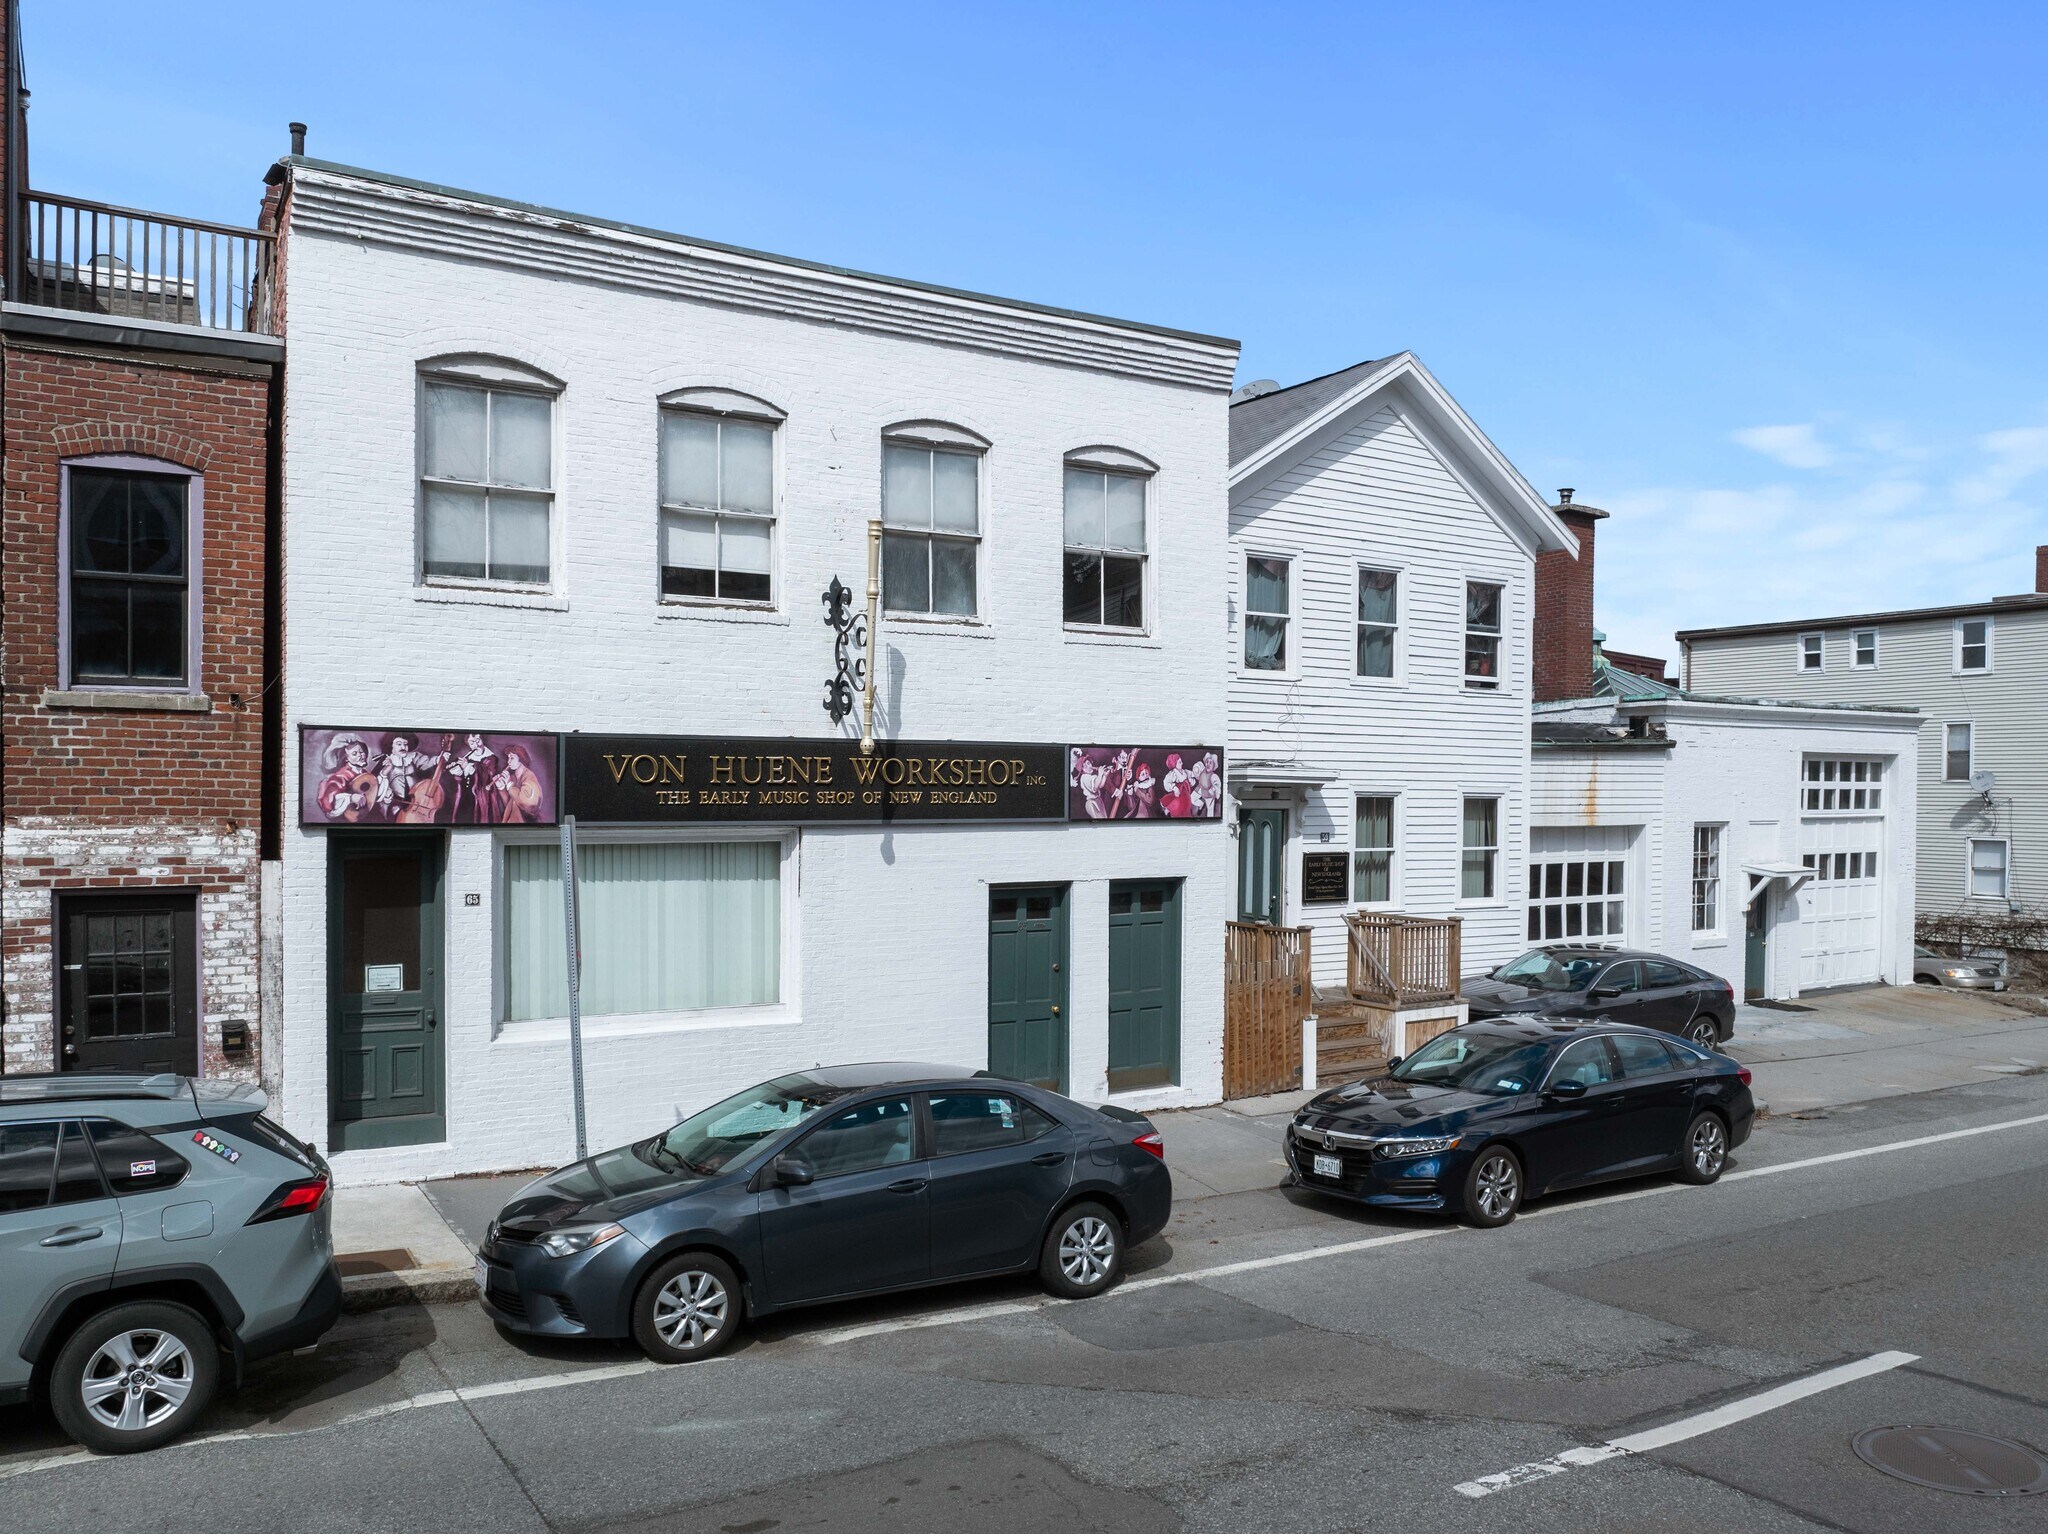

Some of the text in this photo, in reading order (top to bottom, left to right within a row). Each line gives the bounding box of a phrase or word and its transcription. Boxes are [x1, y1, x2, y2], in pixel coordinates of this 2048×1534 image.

[603, 754, 1046, 786] VON HUENE WORKSHOP INC
[656, 790, 998, 805] THE EARLY MUSIC SHOP OF NEW ENGLAND
[467, 895, 479, 905] 65
[132, 1163, 155, 1173] NOPE
